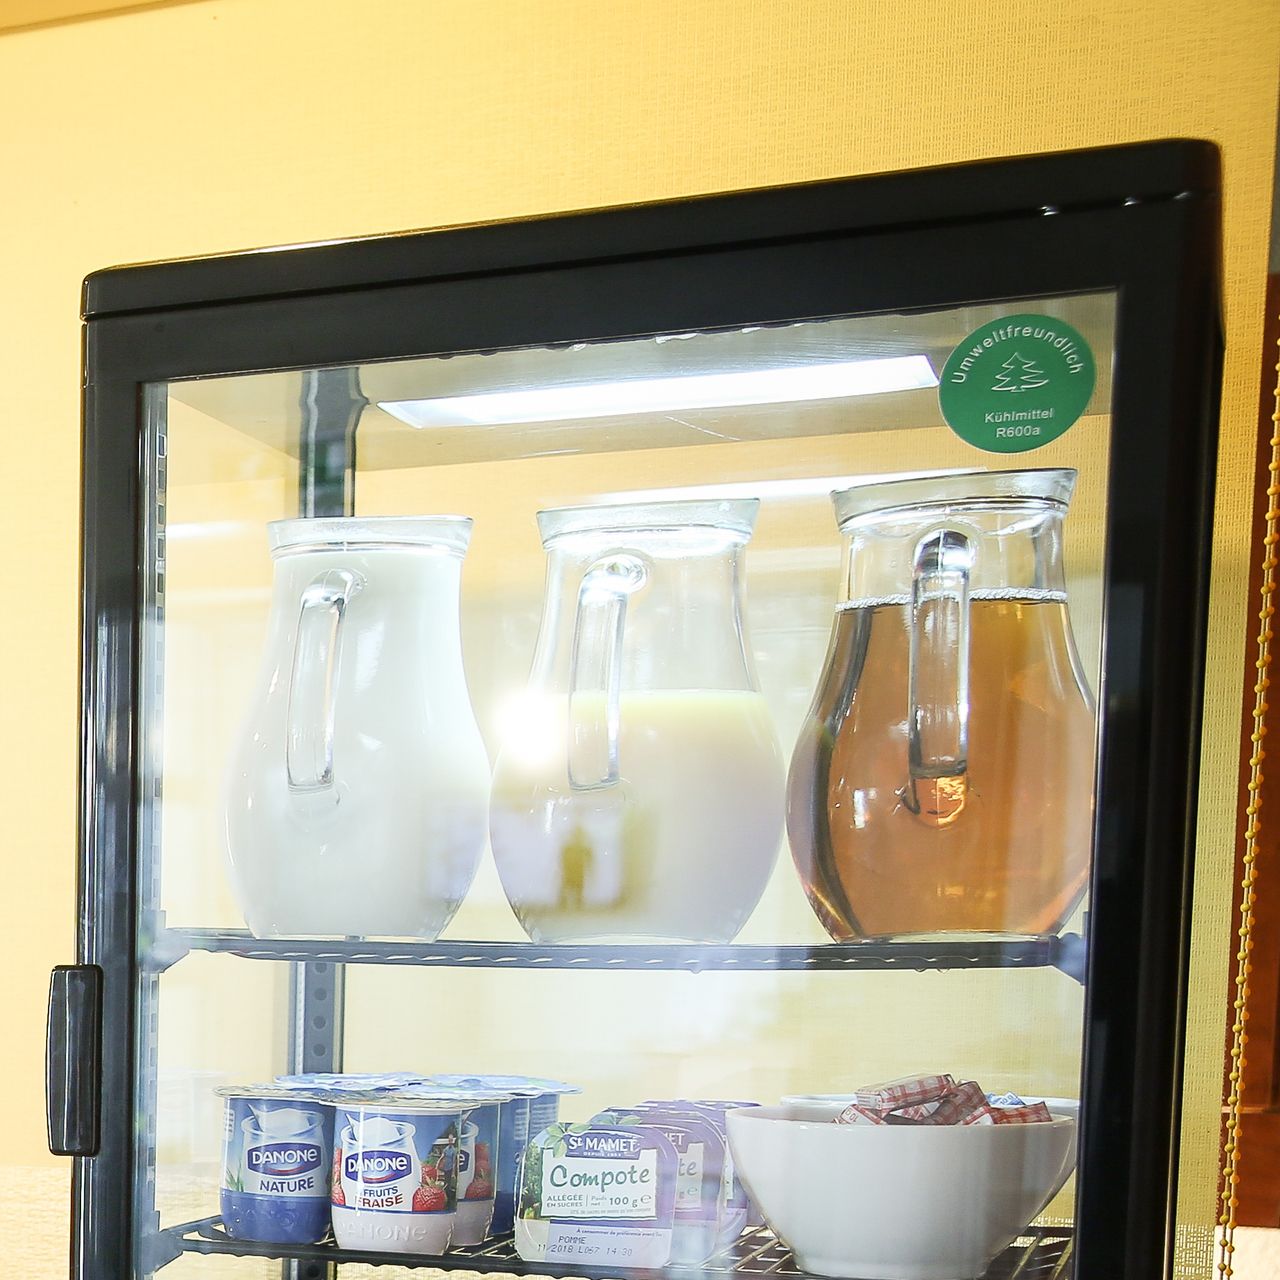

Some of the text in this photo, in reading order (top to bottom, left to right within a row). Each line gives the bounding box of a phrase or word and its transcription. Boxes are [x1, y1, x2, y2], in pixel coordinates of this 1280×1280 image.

[951, 325, 1085, 384] Umweltfreundlich
[984, 408, 1054, 424] Kühlmittel
[996, 425, 1041, 438] R600a
[585, 1137, 638, 1152] MAMET
[259, 1176, 314, 1192] NATURE
[549, 1164, 650, 1193] Compote
[363, 1185, 399, 1198] FRUITS
[609, 1197, 629, 1205] 100
[558, 1235, 587, 1244] POMME
